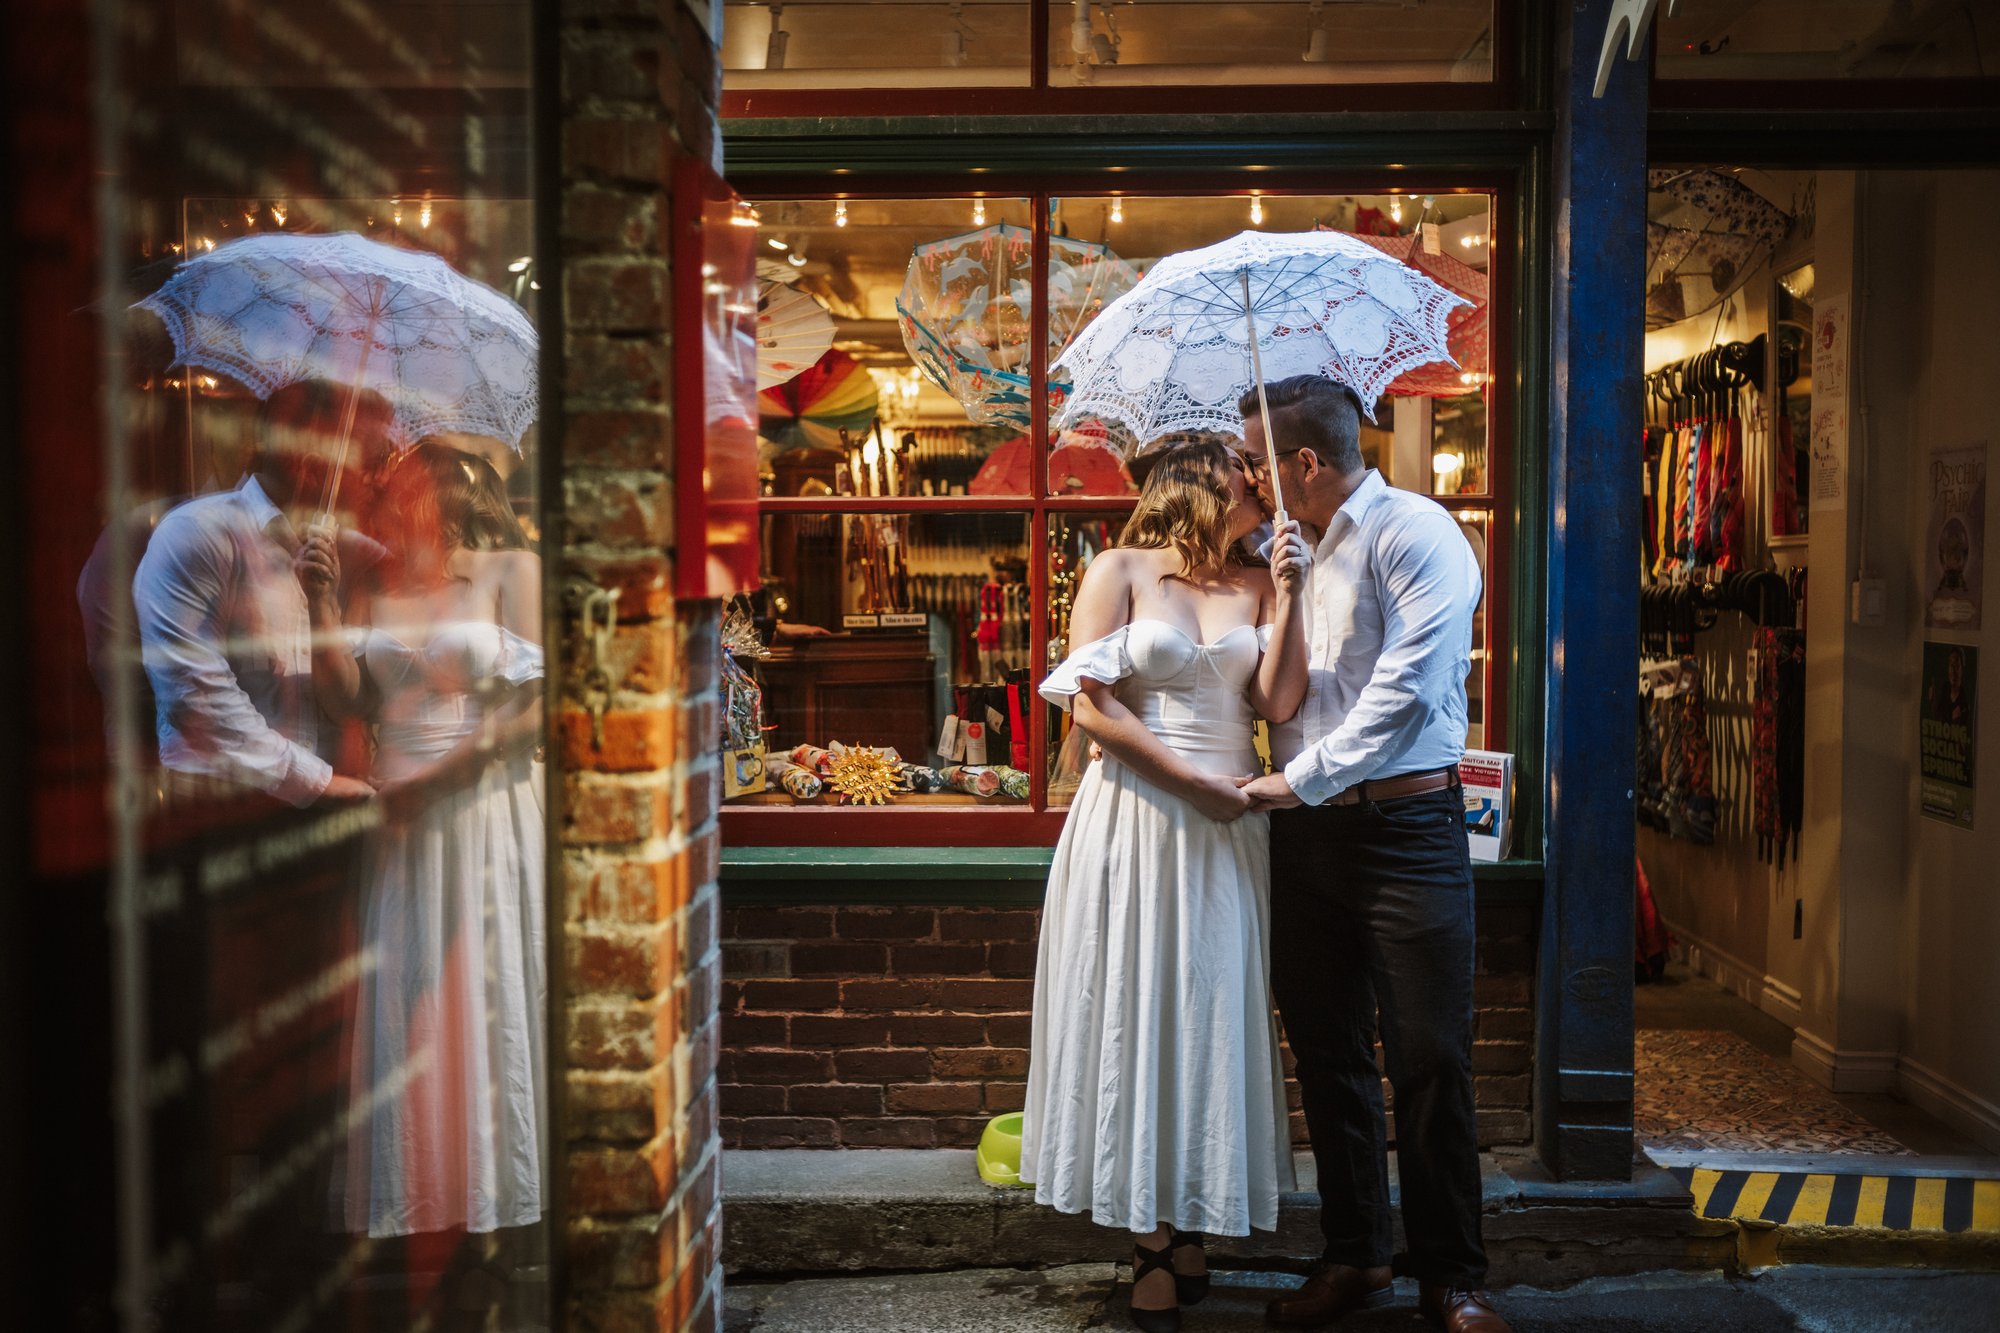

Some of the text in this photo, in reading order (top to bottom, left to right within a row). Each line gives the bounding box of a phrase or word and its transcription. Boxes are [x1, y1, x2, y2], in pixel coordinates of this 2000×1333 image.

[1930, 459, 1985, 502] PSYCHIC
[1940, 488, 1976, 519] FAIR
[1461, 756, 1484, 765] VISITOR
[840, 762, 864, 775] SUN
[1474, 767, 1501, 776] VICTORIA
[843, 772, 873, 789] RAIN
